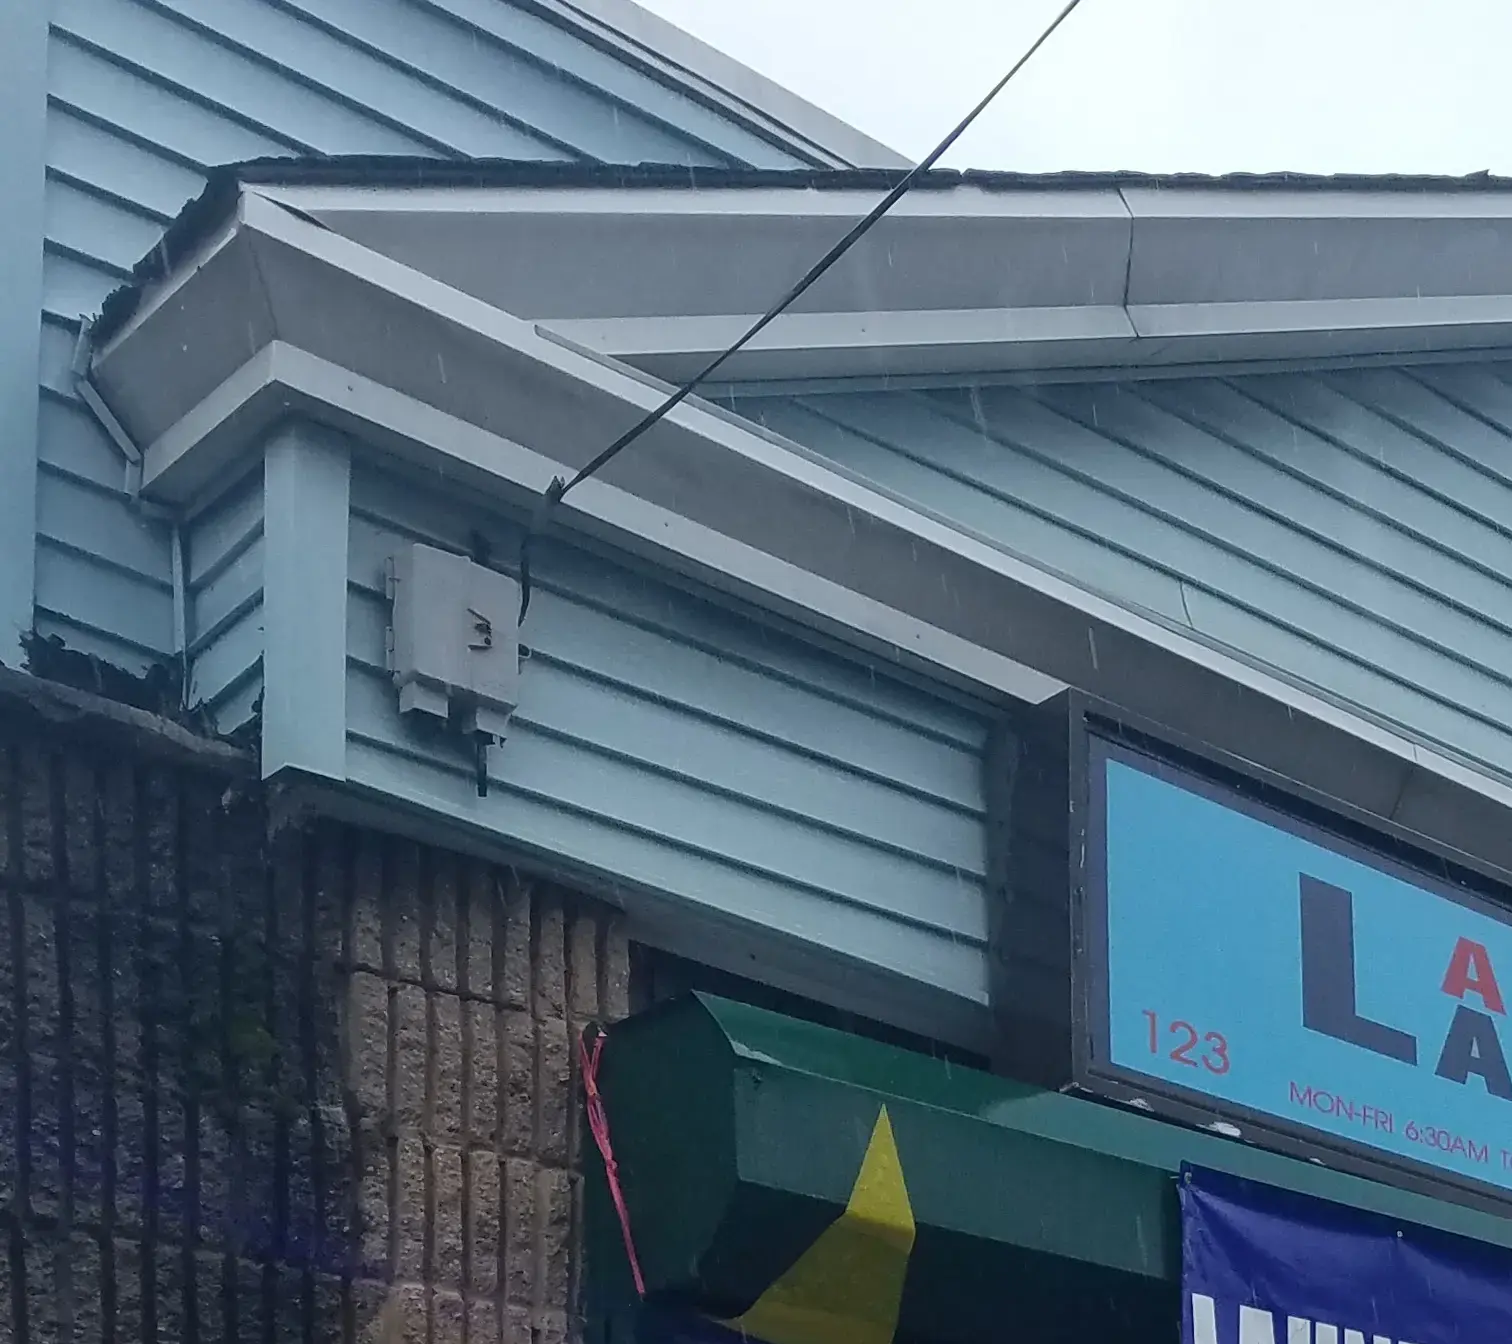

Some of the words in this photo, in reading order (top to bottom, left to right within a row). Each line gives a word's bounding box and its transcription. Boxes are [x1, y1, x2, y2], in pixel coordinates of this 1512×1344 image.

[1142, 1009, 1230, 1076] 123
[1289, 1081, 1393, 1134] MON-FRI
[1405, 1120, 1489, 1164] 6:30AM
